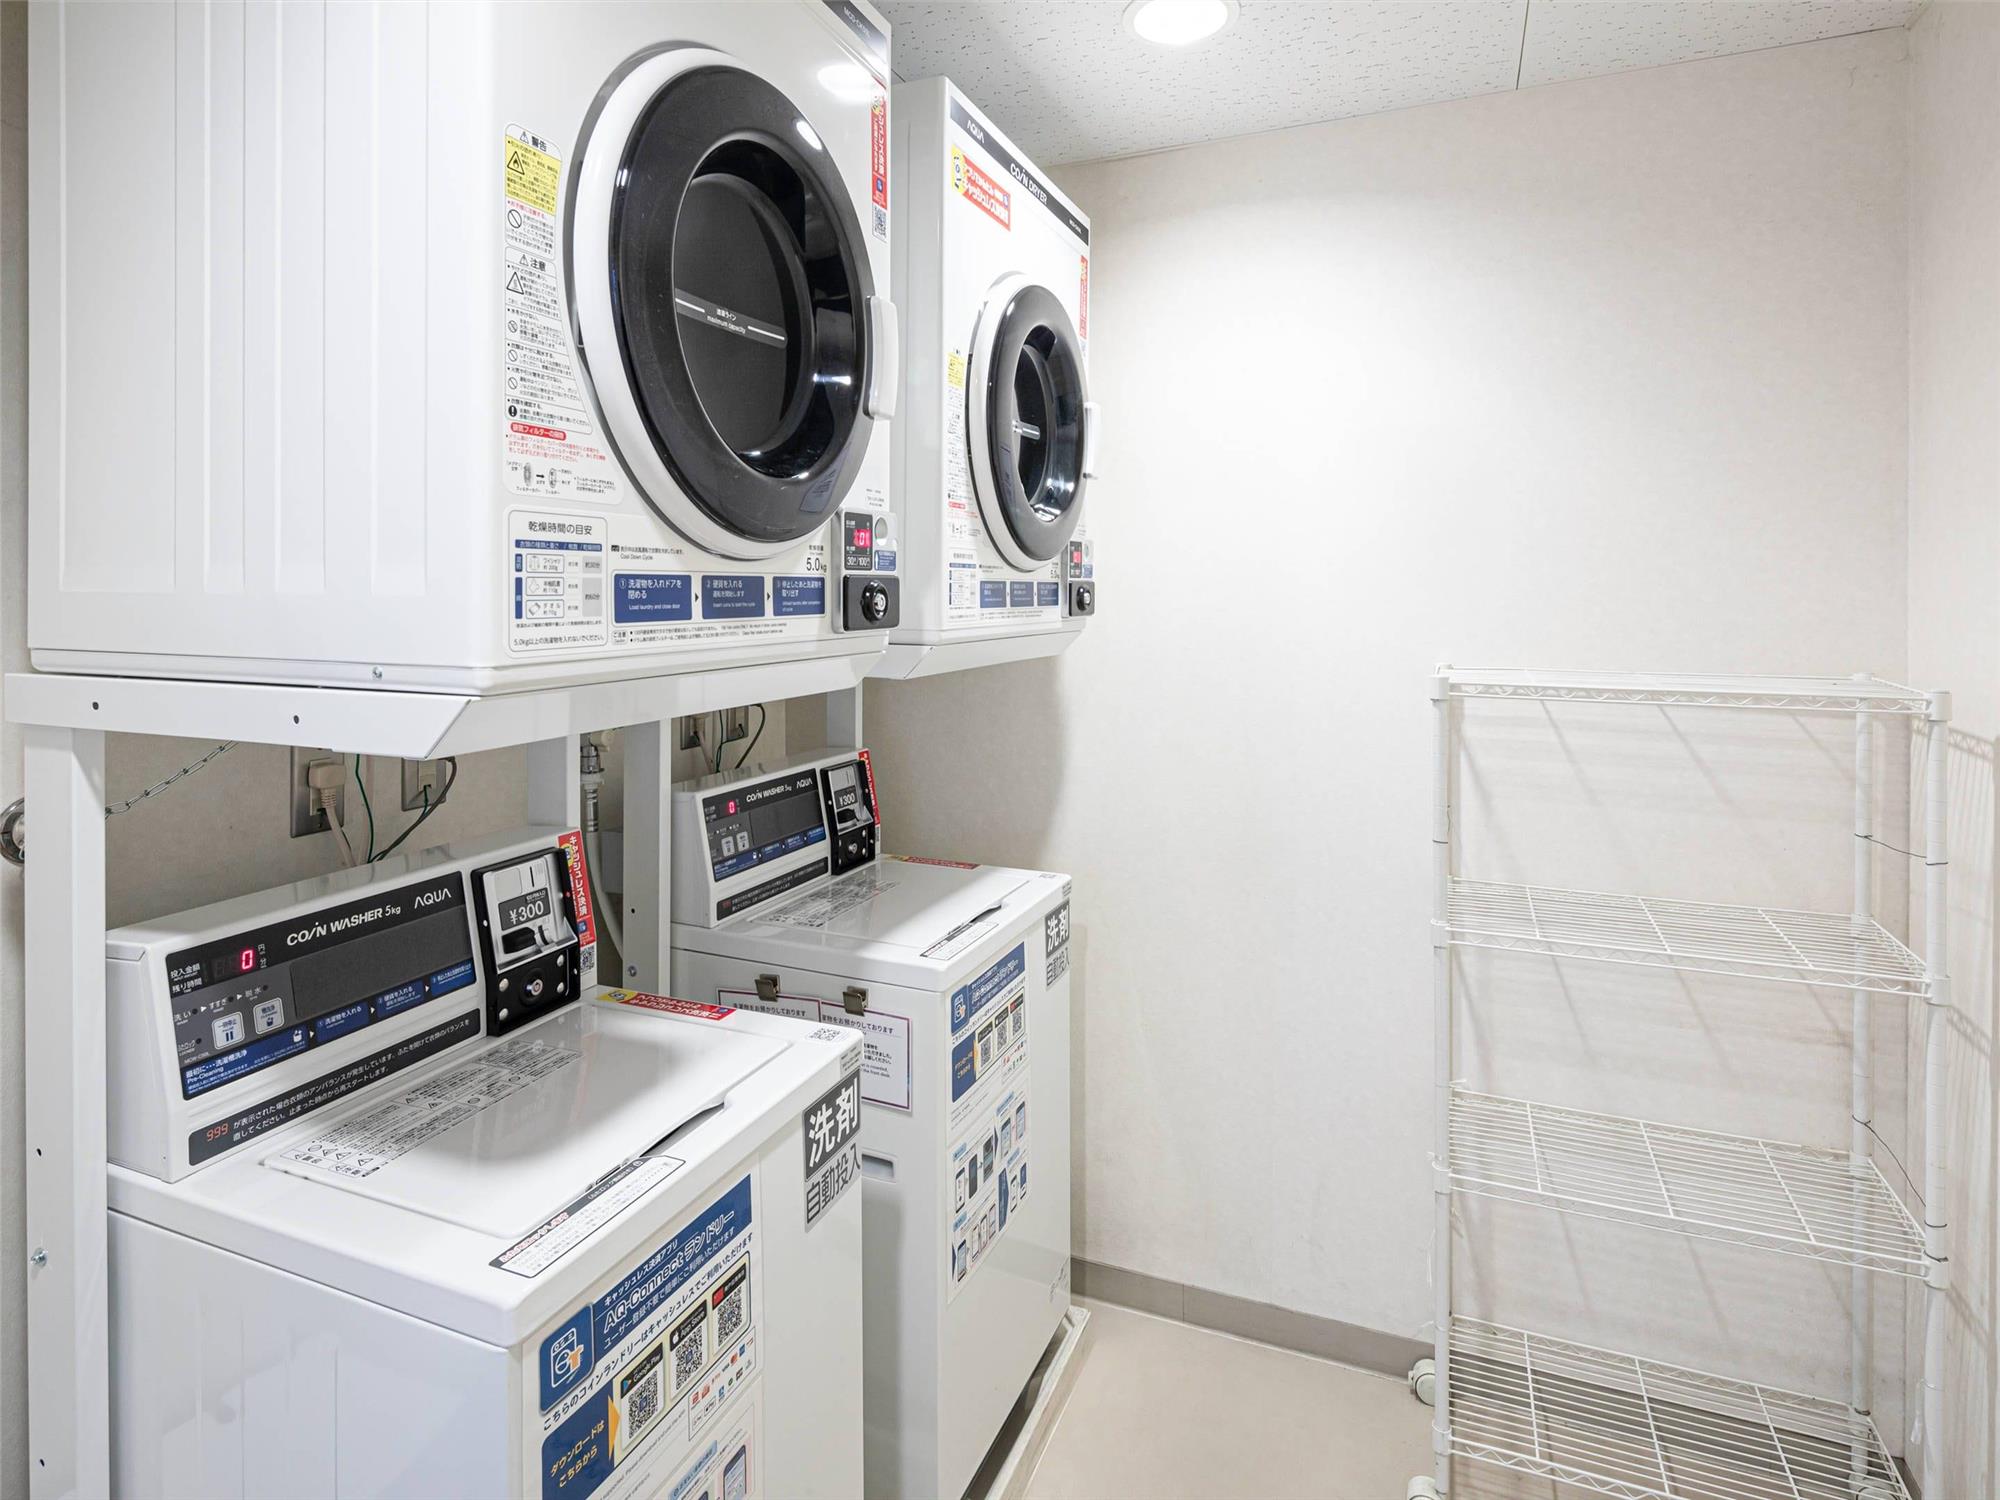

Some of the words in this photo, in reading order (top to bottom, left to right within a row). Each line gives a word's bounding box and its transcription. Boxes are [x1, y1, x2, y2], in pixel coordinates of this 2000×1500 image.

[967, 120, 985, 143] AQUA
[531, 136, 547, 152] 警告
[1028, 178, 1048, 205] DRYER
[530, 257, 546, 272] 注意
[528, 521, 593, 535] 乾燥時間の目安
[627, 578, 682, 589] 洗濯物を入れドアを
[627, 590, 647, 600] 閉める
[763, 785, 785, 798] WASHER
[796, 778, 813, 789] AQUA
[728, 800, 735, 814] 0
[838, 792, 856, 807] ¥300
[569, 835, 588, 917] キャッシュレス決済
[330, 910, 384, 934] WASHER
[384, 904, 402, 917] 5kg
[414, 888, 452, 910] AQUA
[509, 900, 545, 925] ¥300
[1047, 904, 1069, 953] 洗剤
[241, 950, 254, 970] 0
[1046, 946, 1070, 987] 自動投入
[170, 963, 200, 979] 投入金額
[172, 977, 202, 993] 残り時間
[325, 1007, 362, 1026] 洗濯物を入れる
[187, 1067, 225, 1085] Pre-Cleaning
[206, 1123, 230, 1143] 999
[808, 1077, 859, 1168] 洗剤
[806, 1142, 861, 1225] 自動投入
[604, 1238, 678, 1306] キャッシュレス決済アプリ
[604, 1210, 735, 1334] AQ-Connectランドリー
[543, 1232, 752, 1431] こちらのコインランドリーはキャッシュレスでご利用いただけます
[550, 1419, 605, 1478] ダウンロードは
[559, 1445, 598, 1488] こちらから
